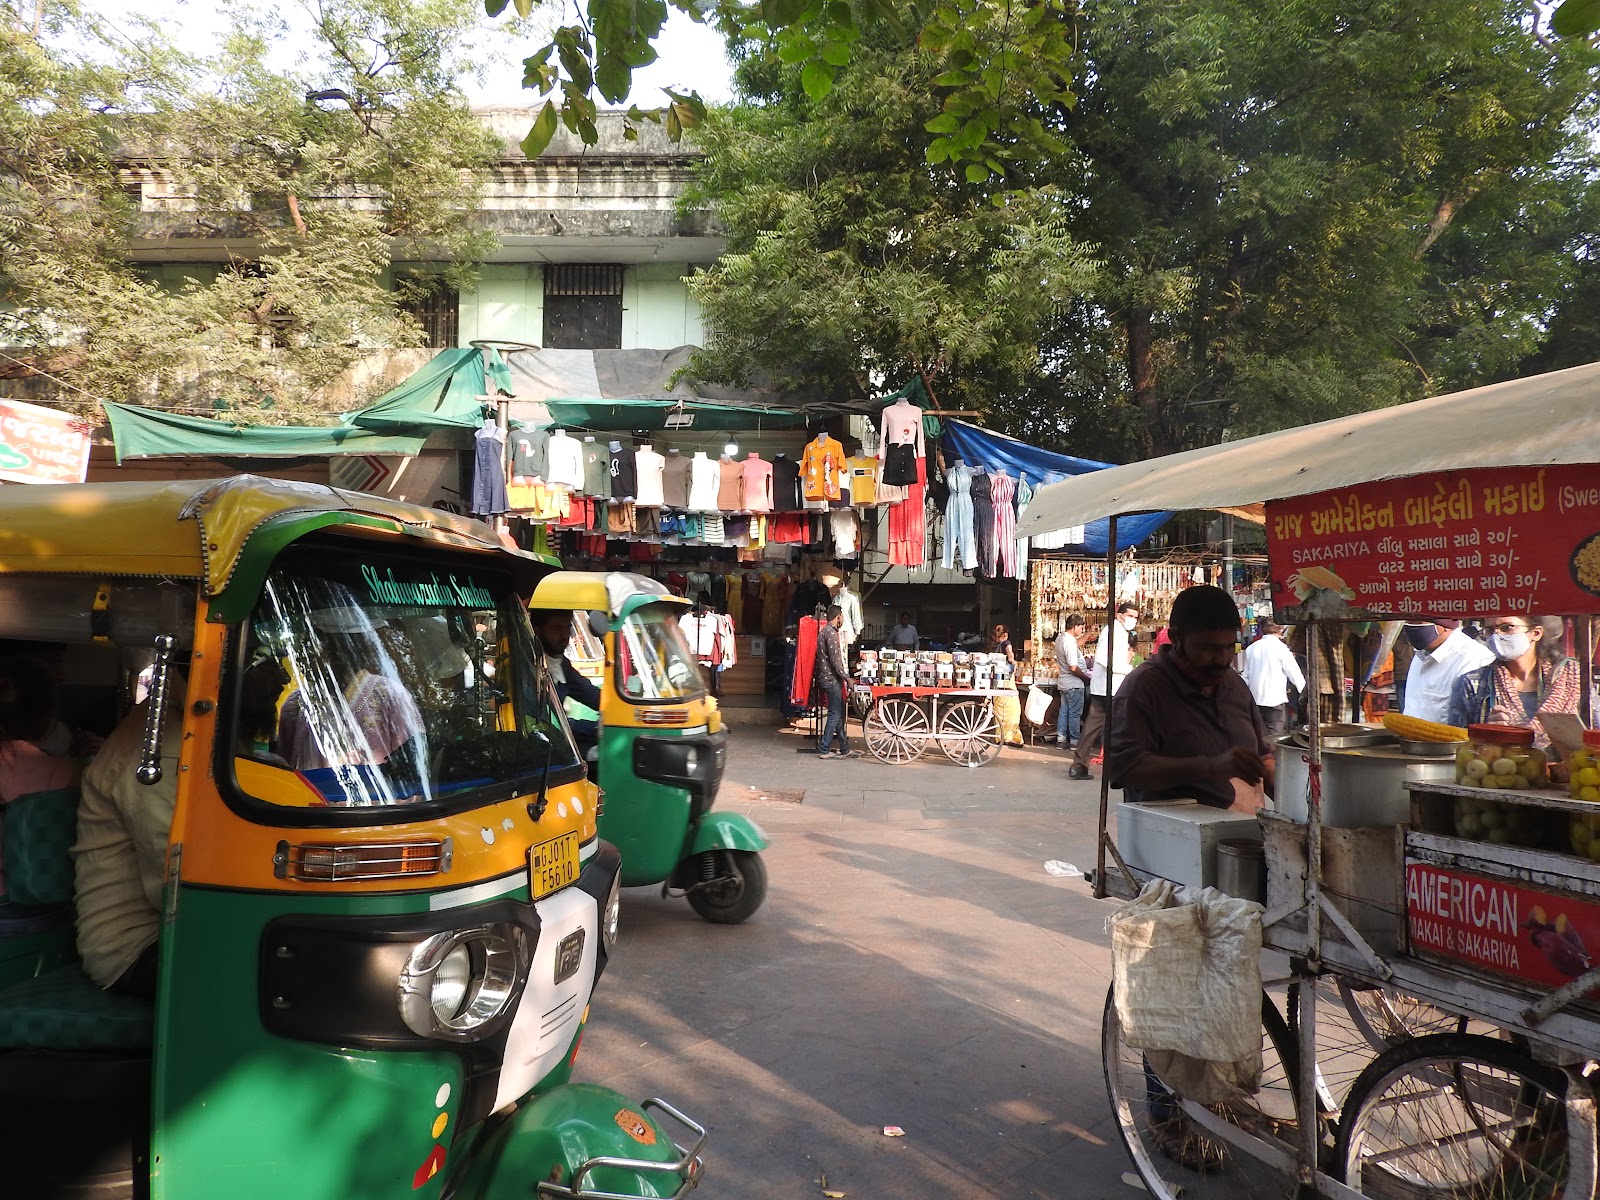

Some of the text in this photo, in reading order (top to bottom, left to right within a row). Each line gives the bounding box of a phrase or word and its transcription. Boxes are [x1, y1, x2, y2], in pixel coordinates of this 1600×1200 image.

[1274, 469, 1545, 540] રાજ અમેરીકન બાફેલી મકાઈ
[1558, 485, 1600, 515] (Swe
[1292, 540, 1370, 564] SAKARIYA
[1377, 535, 1405, 558] લીંબુ
[1408, 536, 1448, 551] મસાલા
[1453, 527, 1480, 548] સાથે
[1378, 560, 1405, 574] બટર
[1410, 557, 1449, 571] મસાલા
[1455, 549, 1482, 569] સાથે
[1359, 576, 1391, 594] આખો
[1395, 575, 1429, 593] મકાઈ
[1434, 577, 1474, 592] મસાલા
[1480, 569, 1508, 590] સાથે
[1366, 601, 1393, 614] બટર
[1398, 595, 1423, 613] ચીઝ
[1427, 599, 1467, 613] મસાલા
[1473, 592, 1501, 612] સાથે
[541, 836, 571, 867] GJ01T
[542, 860, 573, 892] F5610
[1407, 867, 1519, 938] AMERICAN
[1408, 914, 1520, 970] MAKAI & SAKARIYA
